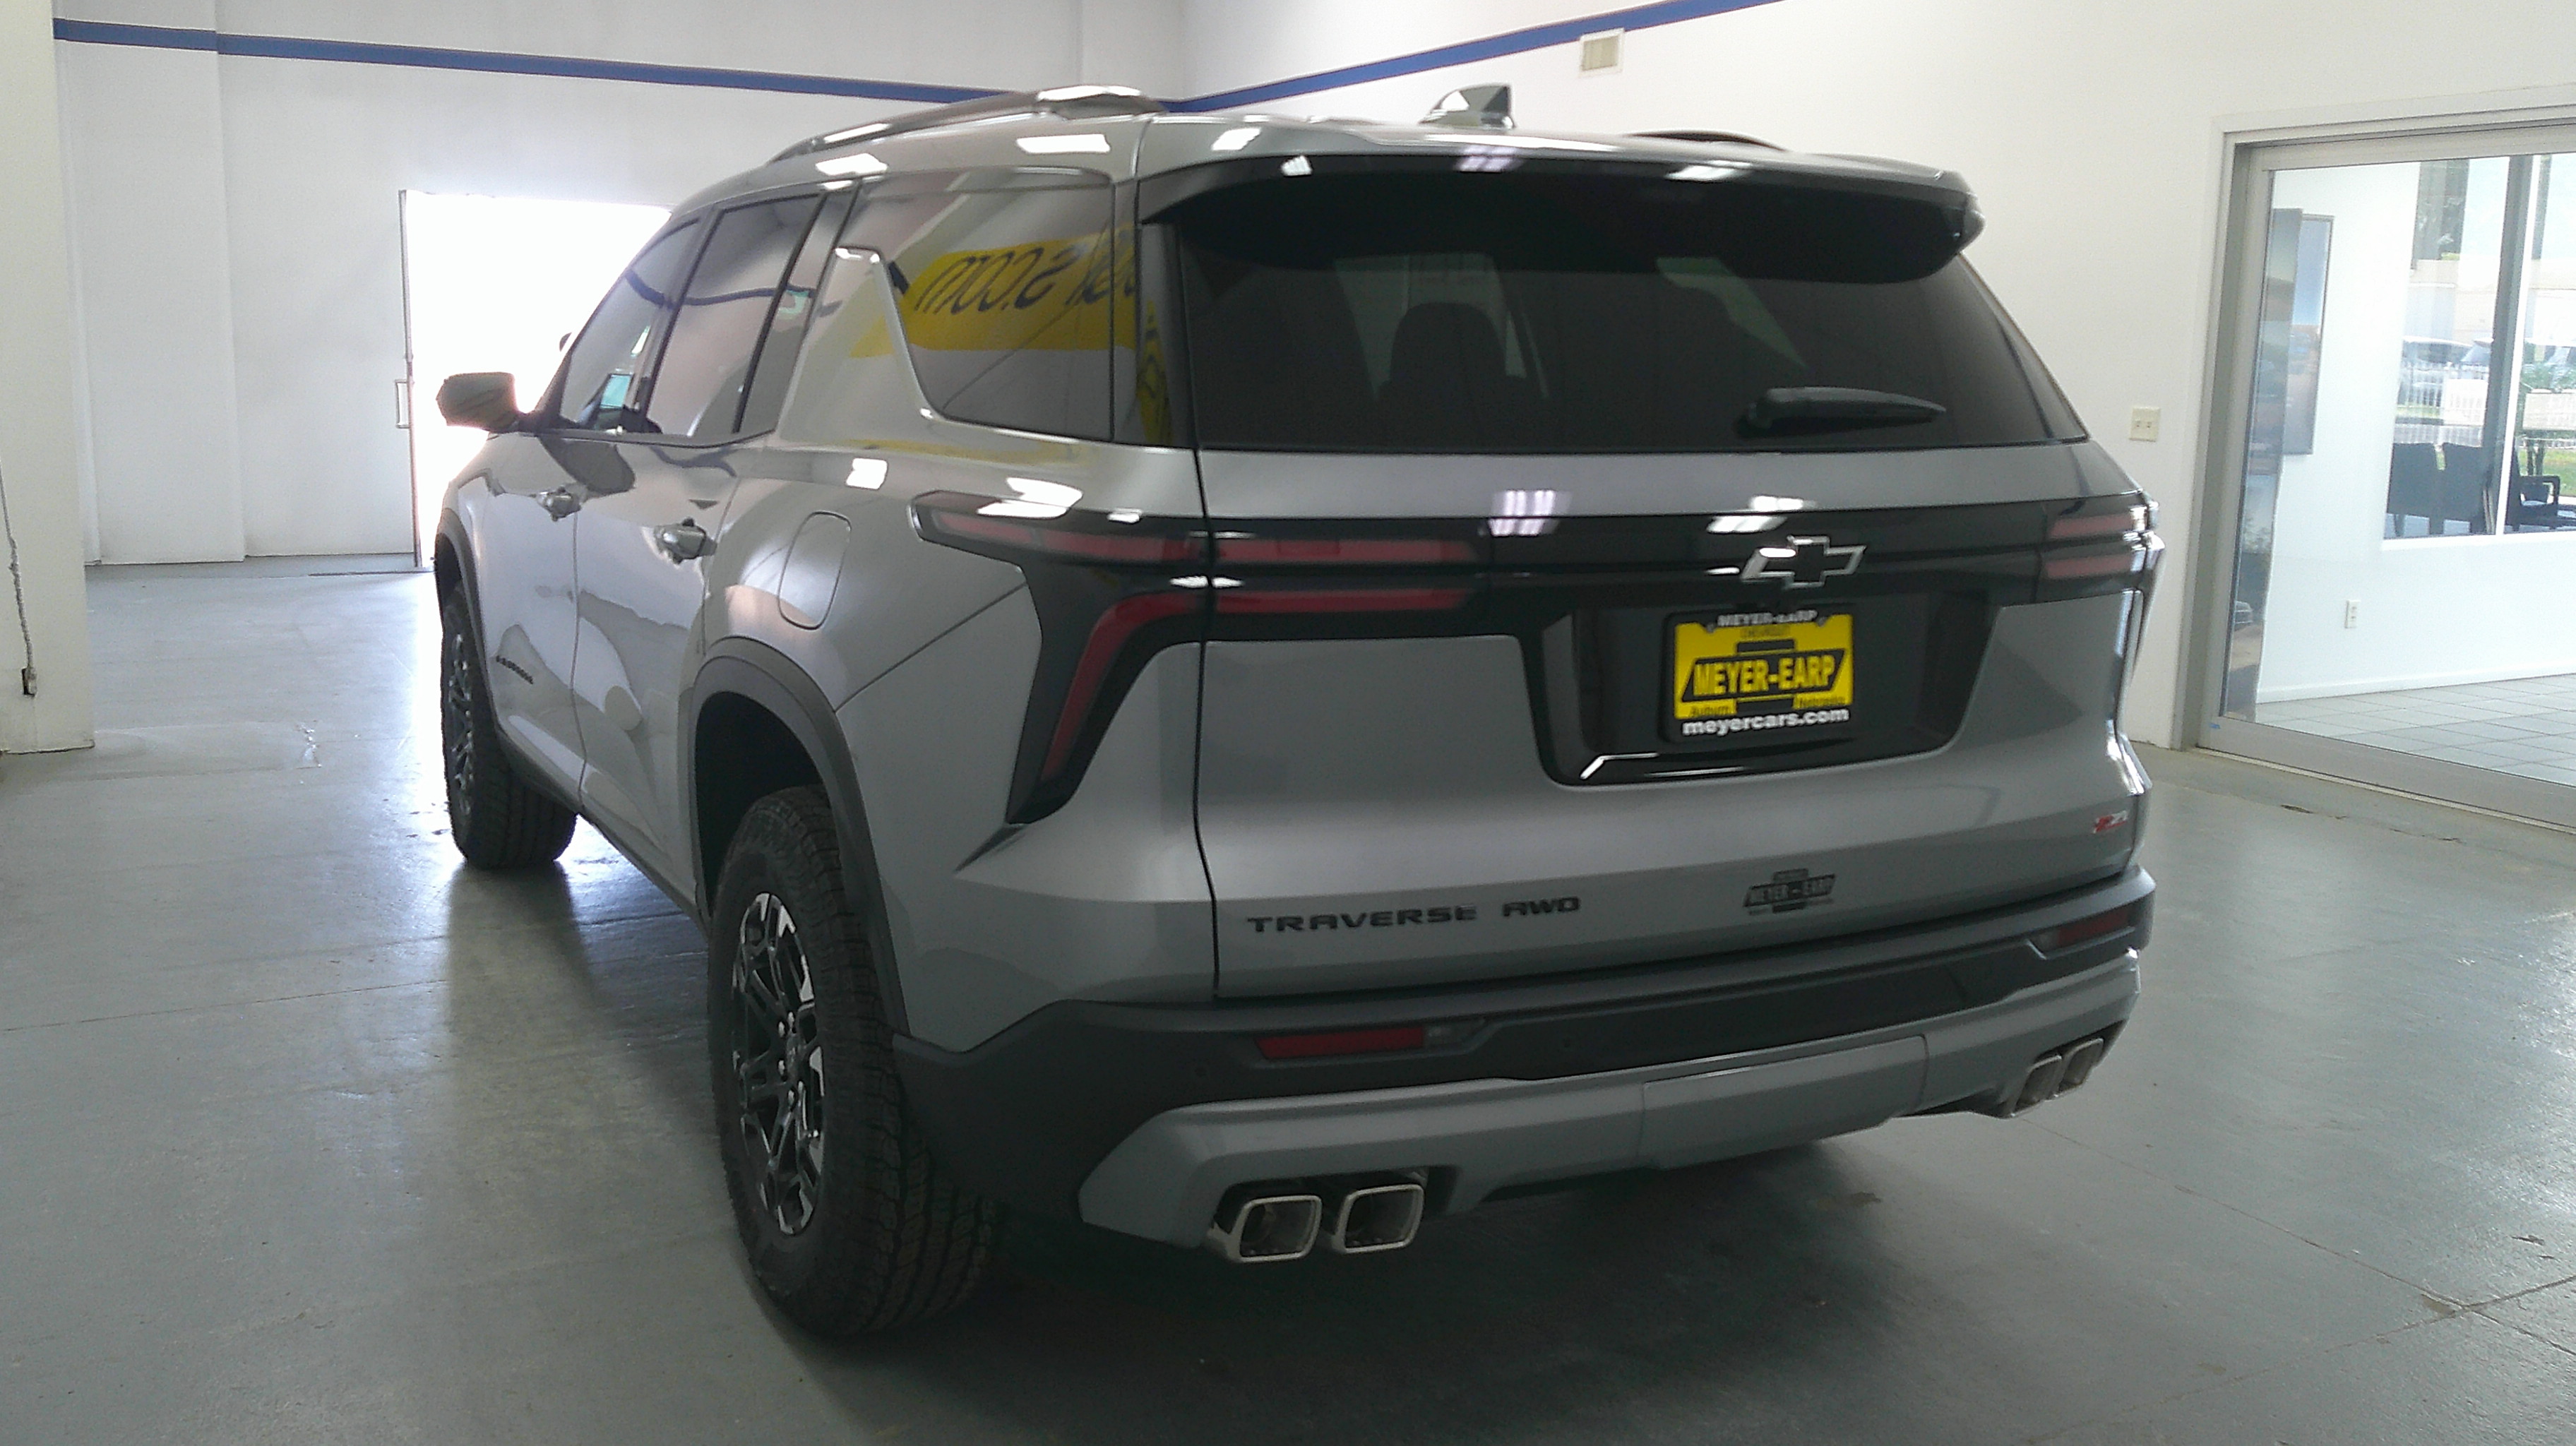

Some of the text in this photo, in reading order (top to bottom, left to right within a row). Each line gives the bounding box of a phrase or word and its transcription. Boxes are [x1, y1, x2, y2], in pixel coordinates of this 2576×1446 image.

[1693, 655, 1835, 697] MEYER-EARP
[1682, 708, 1851, 736] meyercars.com
[1247, 896, 1581, 933] TRAVERSE AWD
